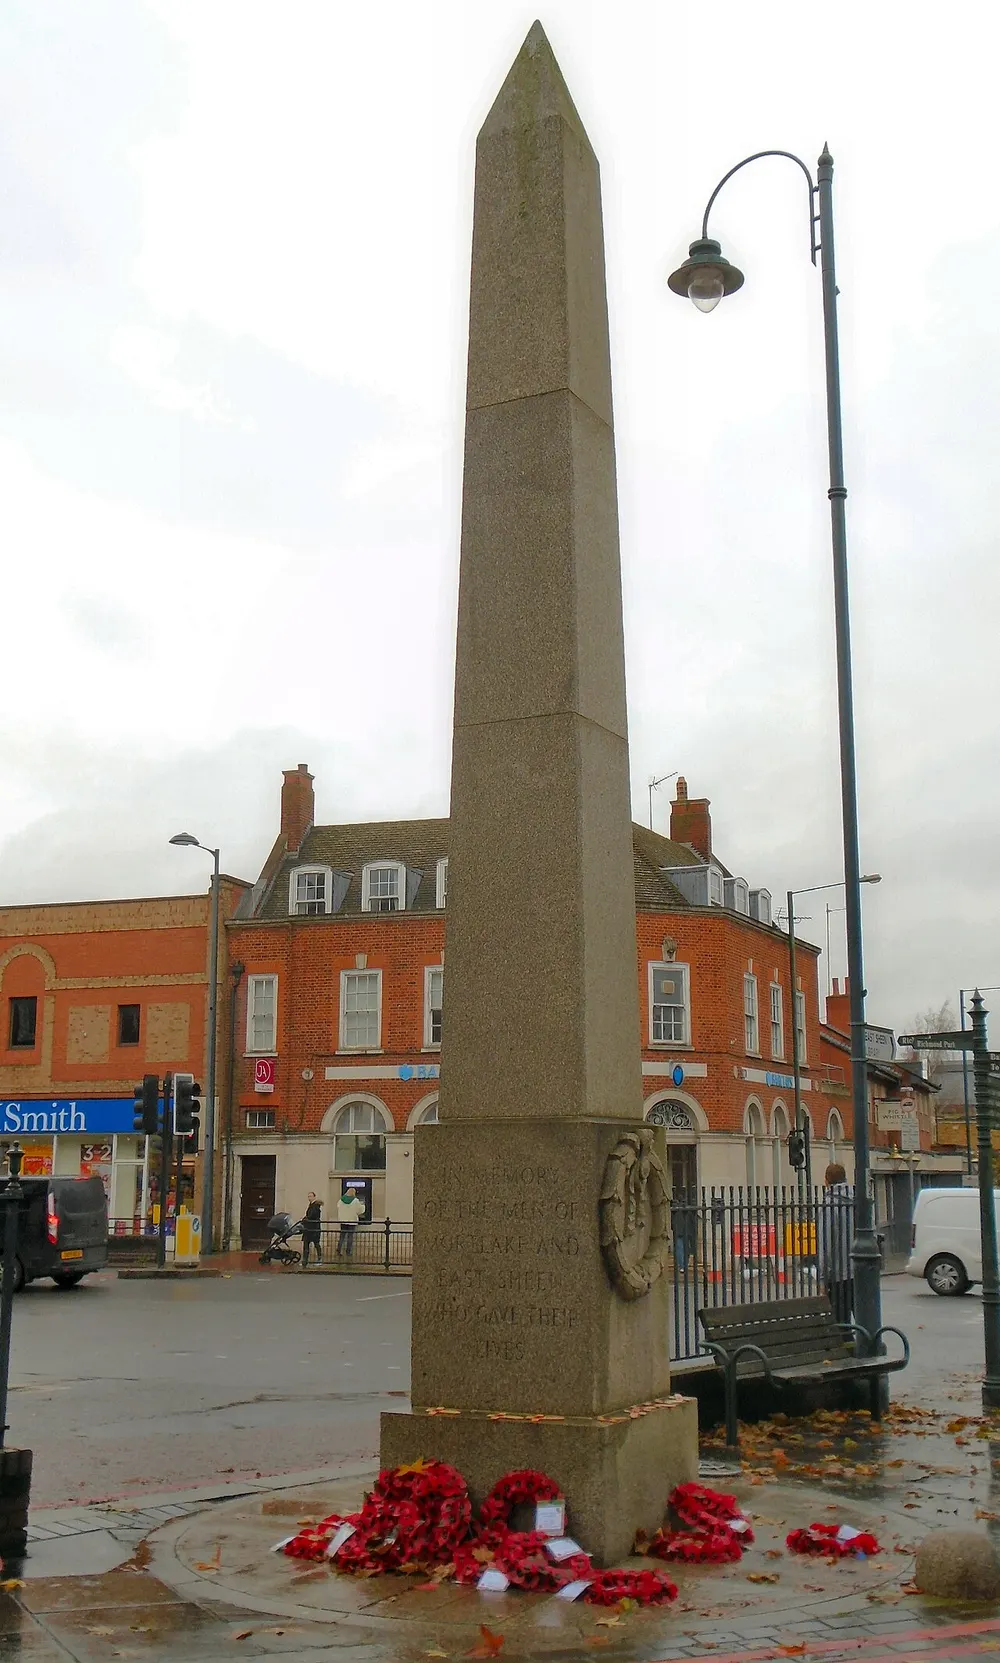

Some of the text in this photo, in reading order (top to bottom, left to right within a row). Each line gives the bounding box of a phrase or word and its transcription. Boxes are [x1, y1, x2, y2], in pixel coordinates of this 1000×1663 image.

[917, 1040, 956, 1049] Richmond Park
[0, 1102, 87, 1132] Smith
[555, 1201, 578, 1220] OF
[536, 1235, 580, 1256] AND
[437, 1268, 483, 1288] EAST
[475, 1305, 519, 1324] GAVE
[523, 1307, 581, 1328] THEIR
